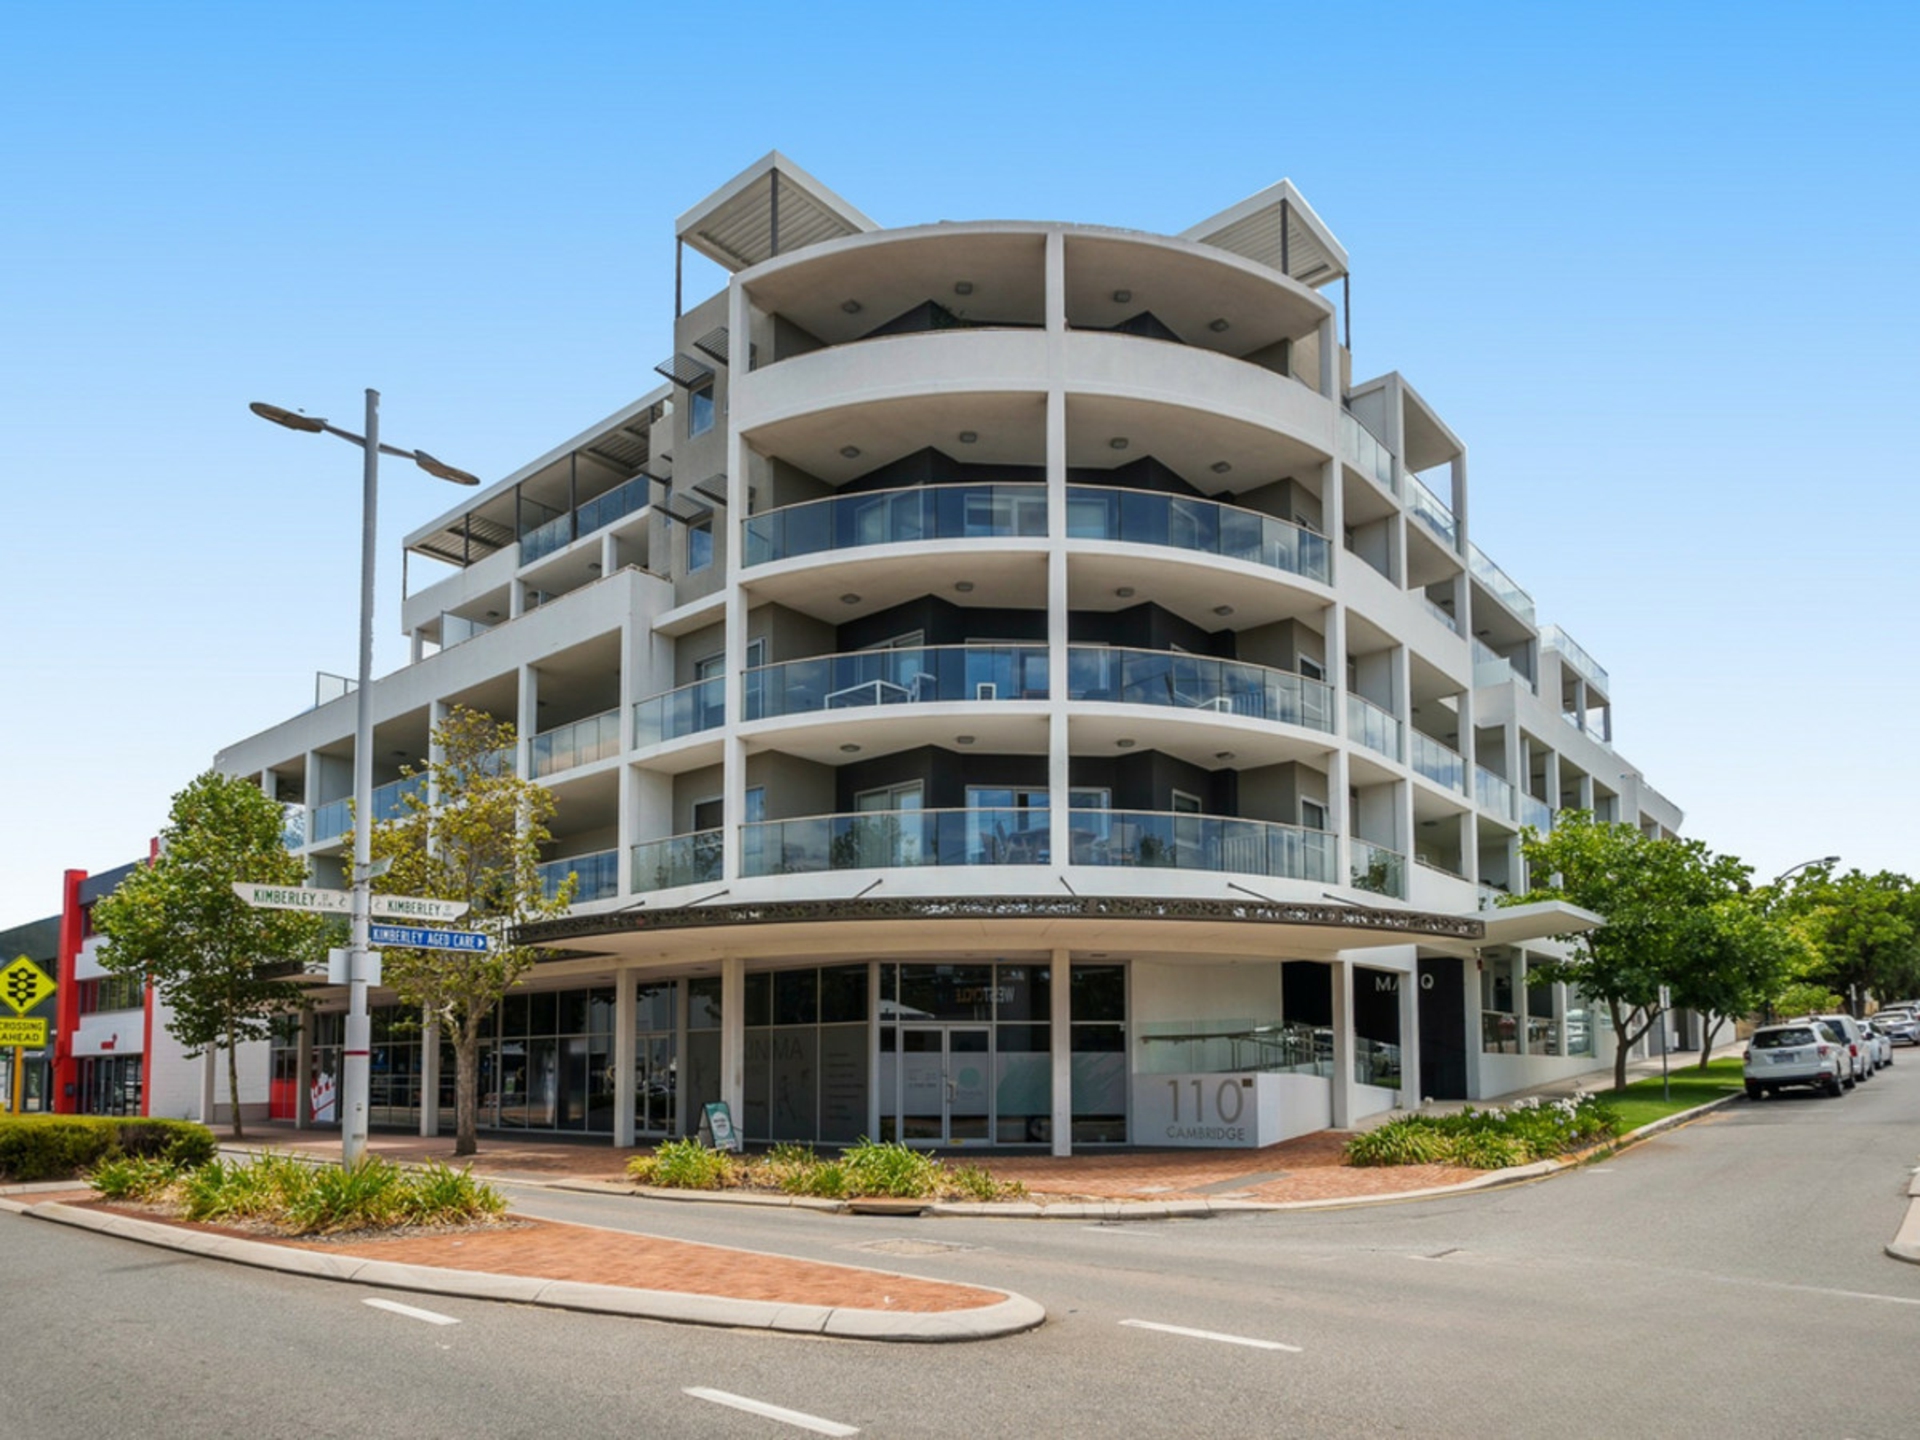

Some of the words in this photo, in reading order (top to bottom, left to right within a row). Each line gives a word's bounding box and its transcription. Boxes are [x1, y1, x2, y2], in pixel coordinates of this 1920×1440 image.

[253, 888, 316, 907] KIMBERLEY
[387, 900, 441, 916] KIMBERLEY
[372, 928, 424, 944] KIMBERLEY
[427, 932, 450, 947] AGED
[453, 934, 475, 949] CARE
[1375, 973, 1435, 992] MQ
[0, 1032, 40, 1042] AHEAD
[1167, 1079, 1244, 1124] 110
[1166, 1125, 1246, 1141] CAMBRIDGE
